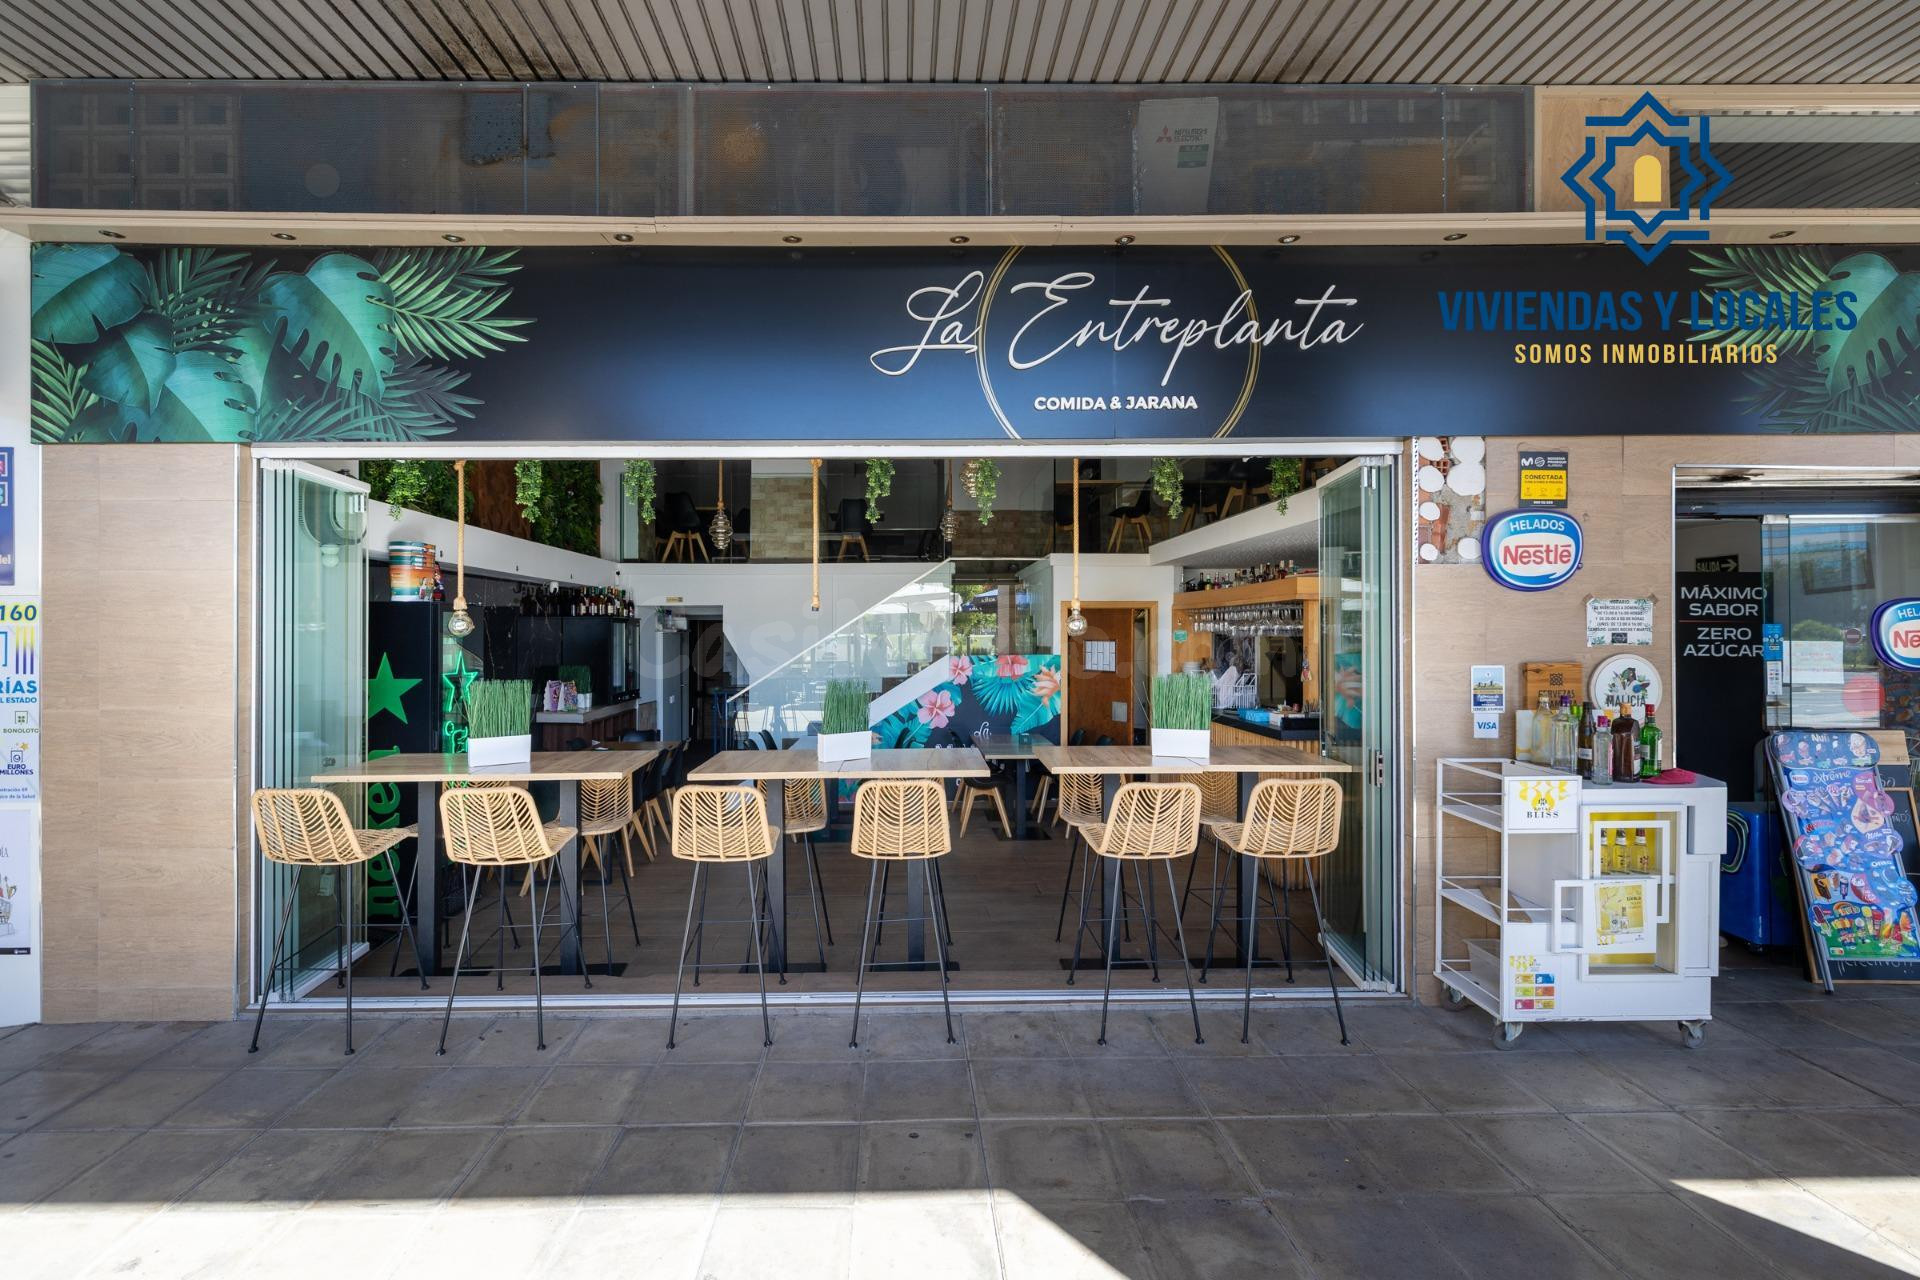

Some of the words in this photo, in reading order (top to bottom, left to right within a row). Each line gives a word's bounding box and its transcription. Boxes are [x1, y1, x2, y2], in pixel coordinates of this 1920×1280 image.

[870, 270, 982, 376] La
[1008, 272, 1365, 387] Entreplanta
[1034, 396, 1107, 411] COMIDA
[1109, 396, 1122, 411] &
[1125, 396, 1198, 410] JARANA
[1509, 519, 1565, 532] HELADOS
[1681, 585, 1767, 600] MÁXIMO
[1689, 603, 1759, 616] SABOR
[1697, 627, 1752, 640] ZERO
[1683, 641, 1765, 657] AZÚCAR
[1607, 694, 1646, 707] MALICIA
[1477, 721, 1497, 730] VISA
